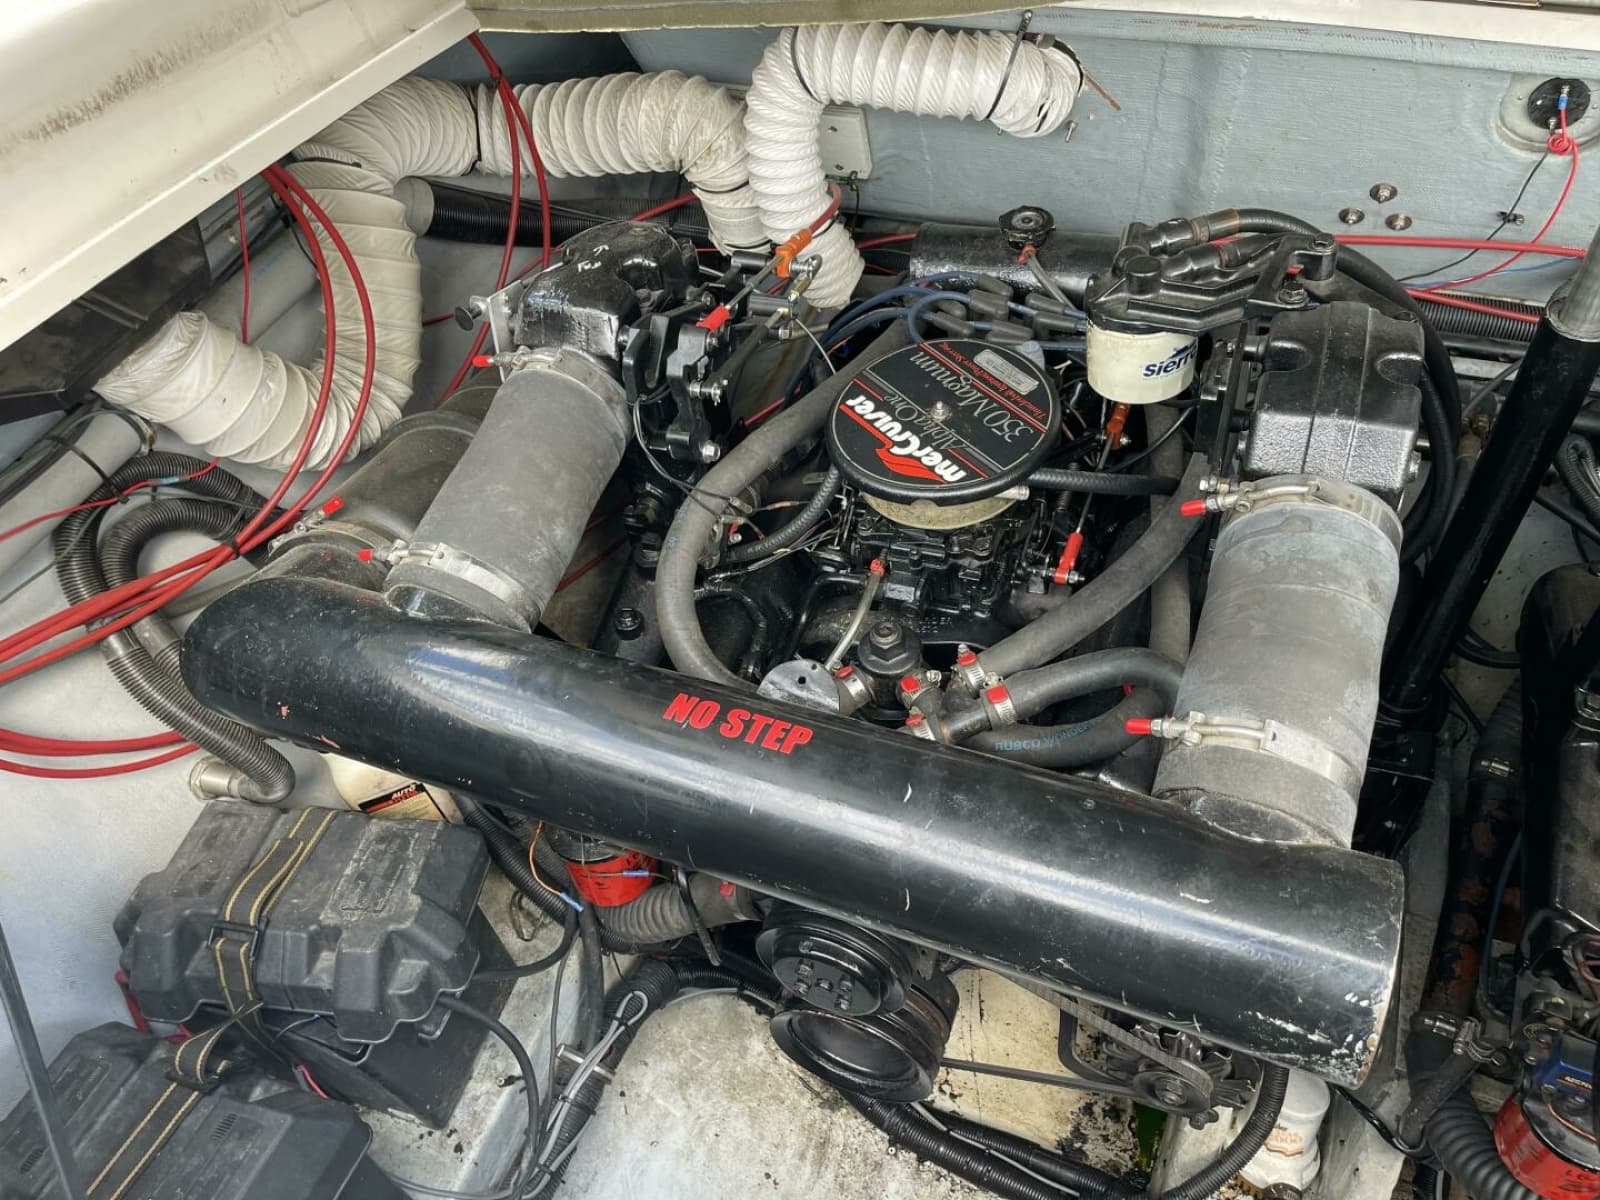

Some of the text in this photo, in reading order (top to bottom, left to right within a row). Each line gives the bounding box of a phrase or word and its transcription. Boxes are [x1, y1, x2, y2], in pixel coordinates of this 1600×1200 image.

[909, 351, 999, 417] Magnum
[883, 394, 967, 450] Alpha One
[983, 410, 1034, 443] 350
[663, 692, 814, 754] NO STEP
